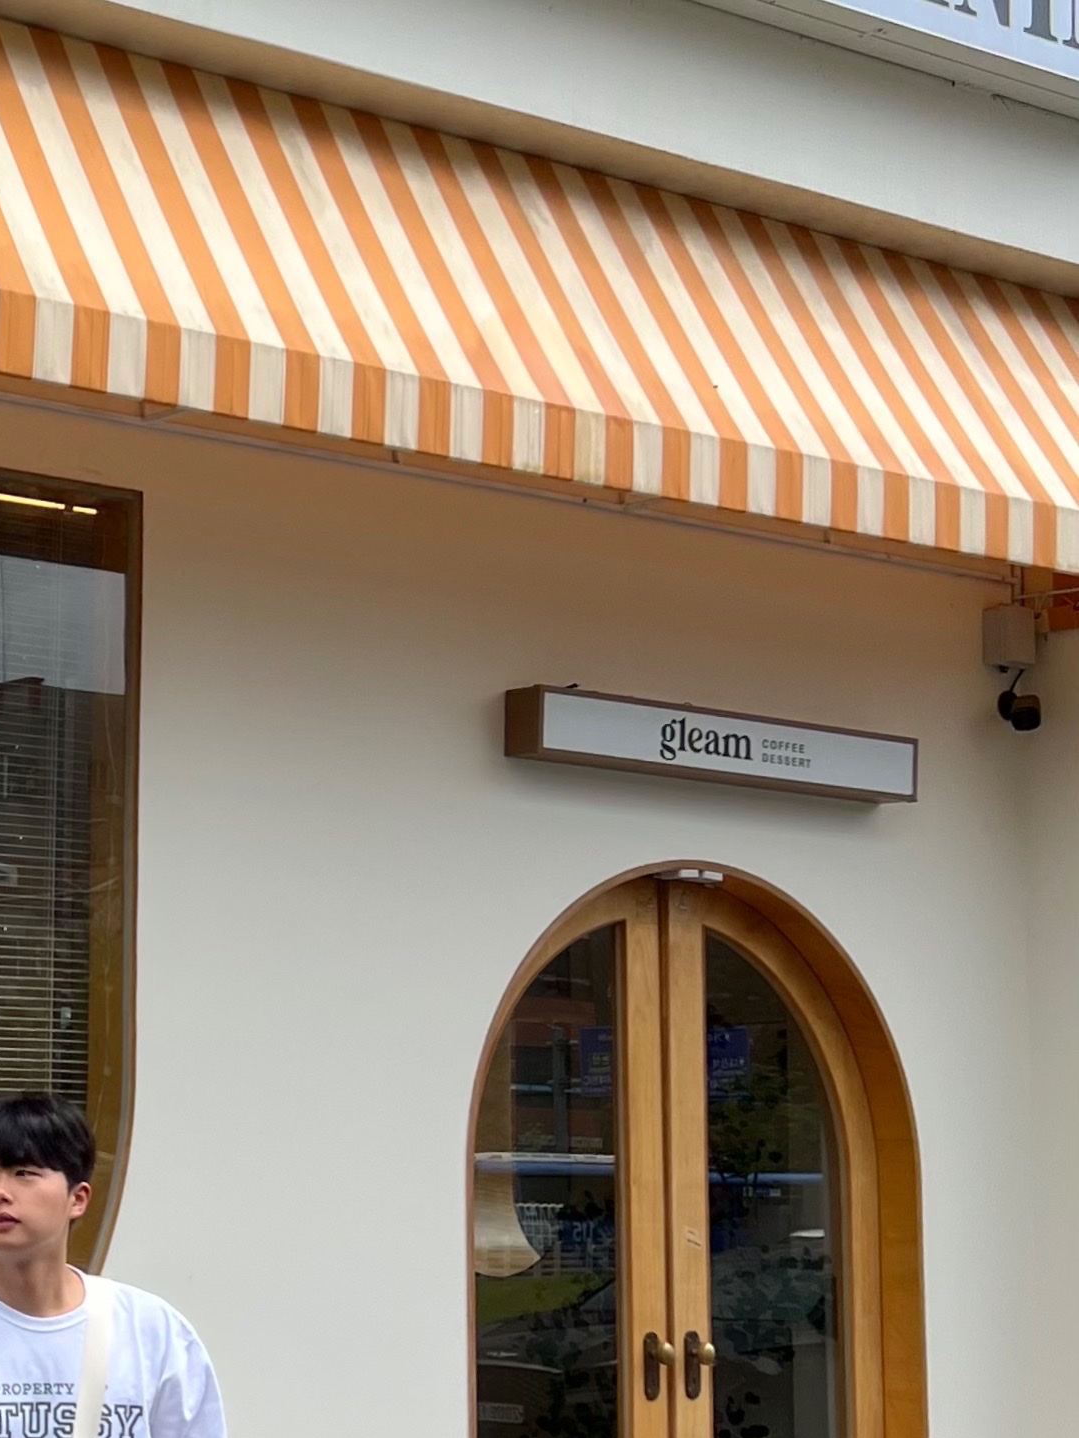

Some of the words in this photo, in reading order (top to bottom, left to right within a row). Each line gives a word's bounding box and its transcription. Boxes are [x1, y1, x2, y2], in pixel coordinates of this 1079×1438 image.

[659, 717, 753, 761] gleam
[761, 738, 806, 754] COFFEE
[761, 752, 812, 769] DESSERT
